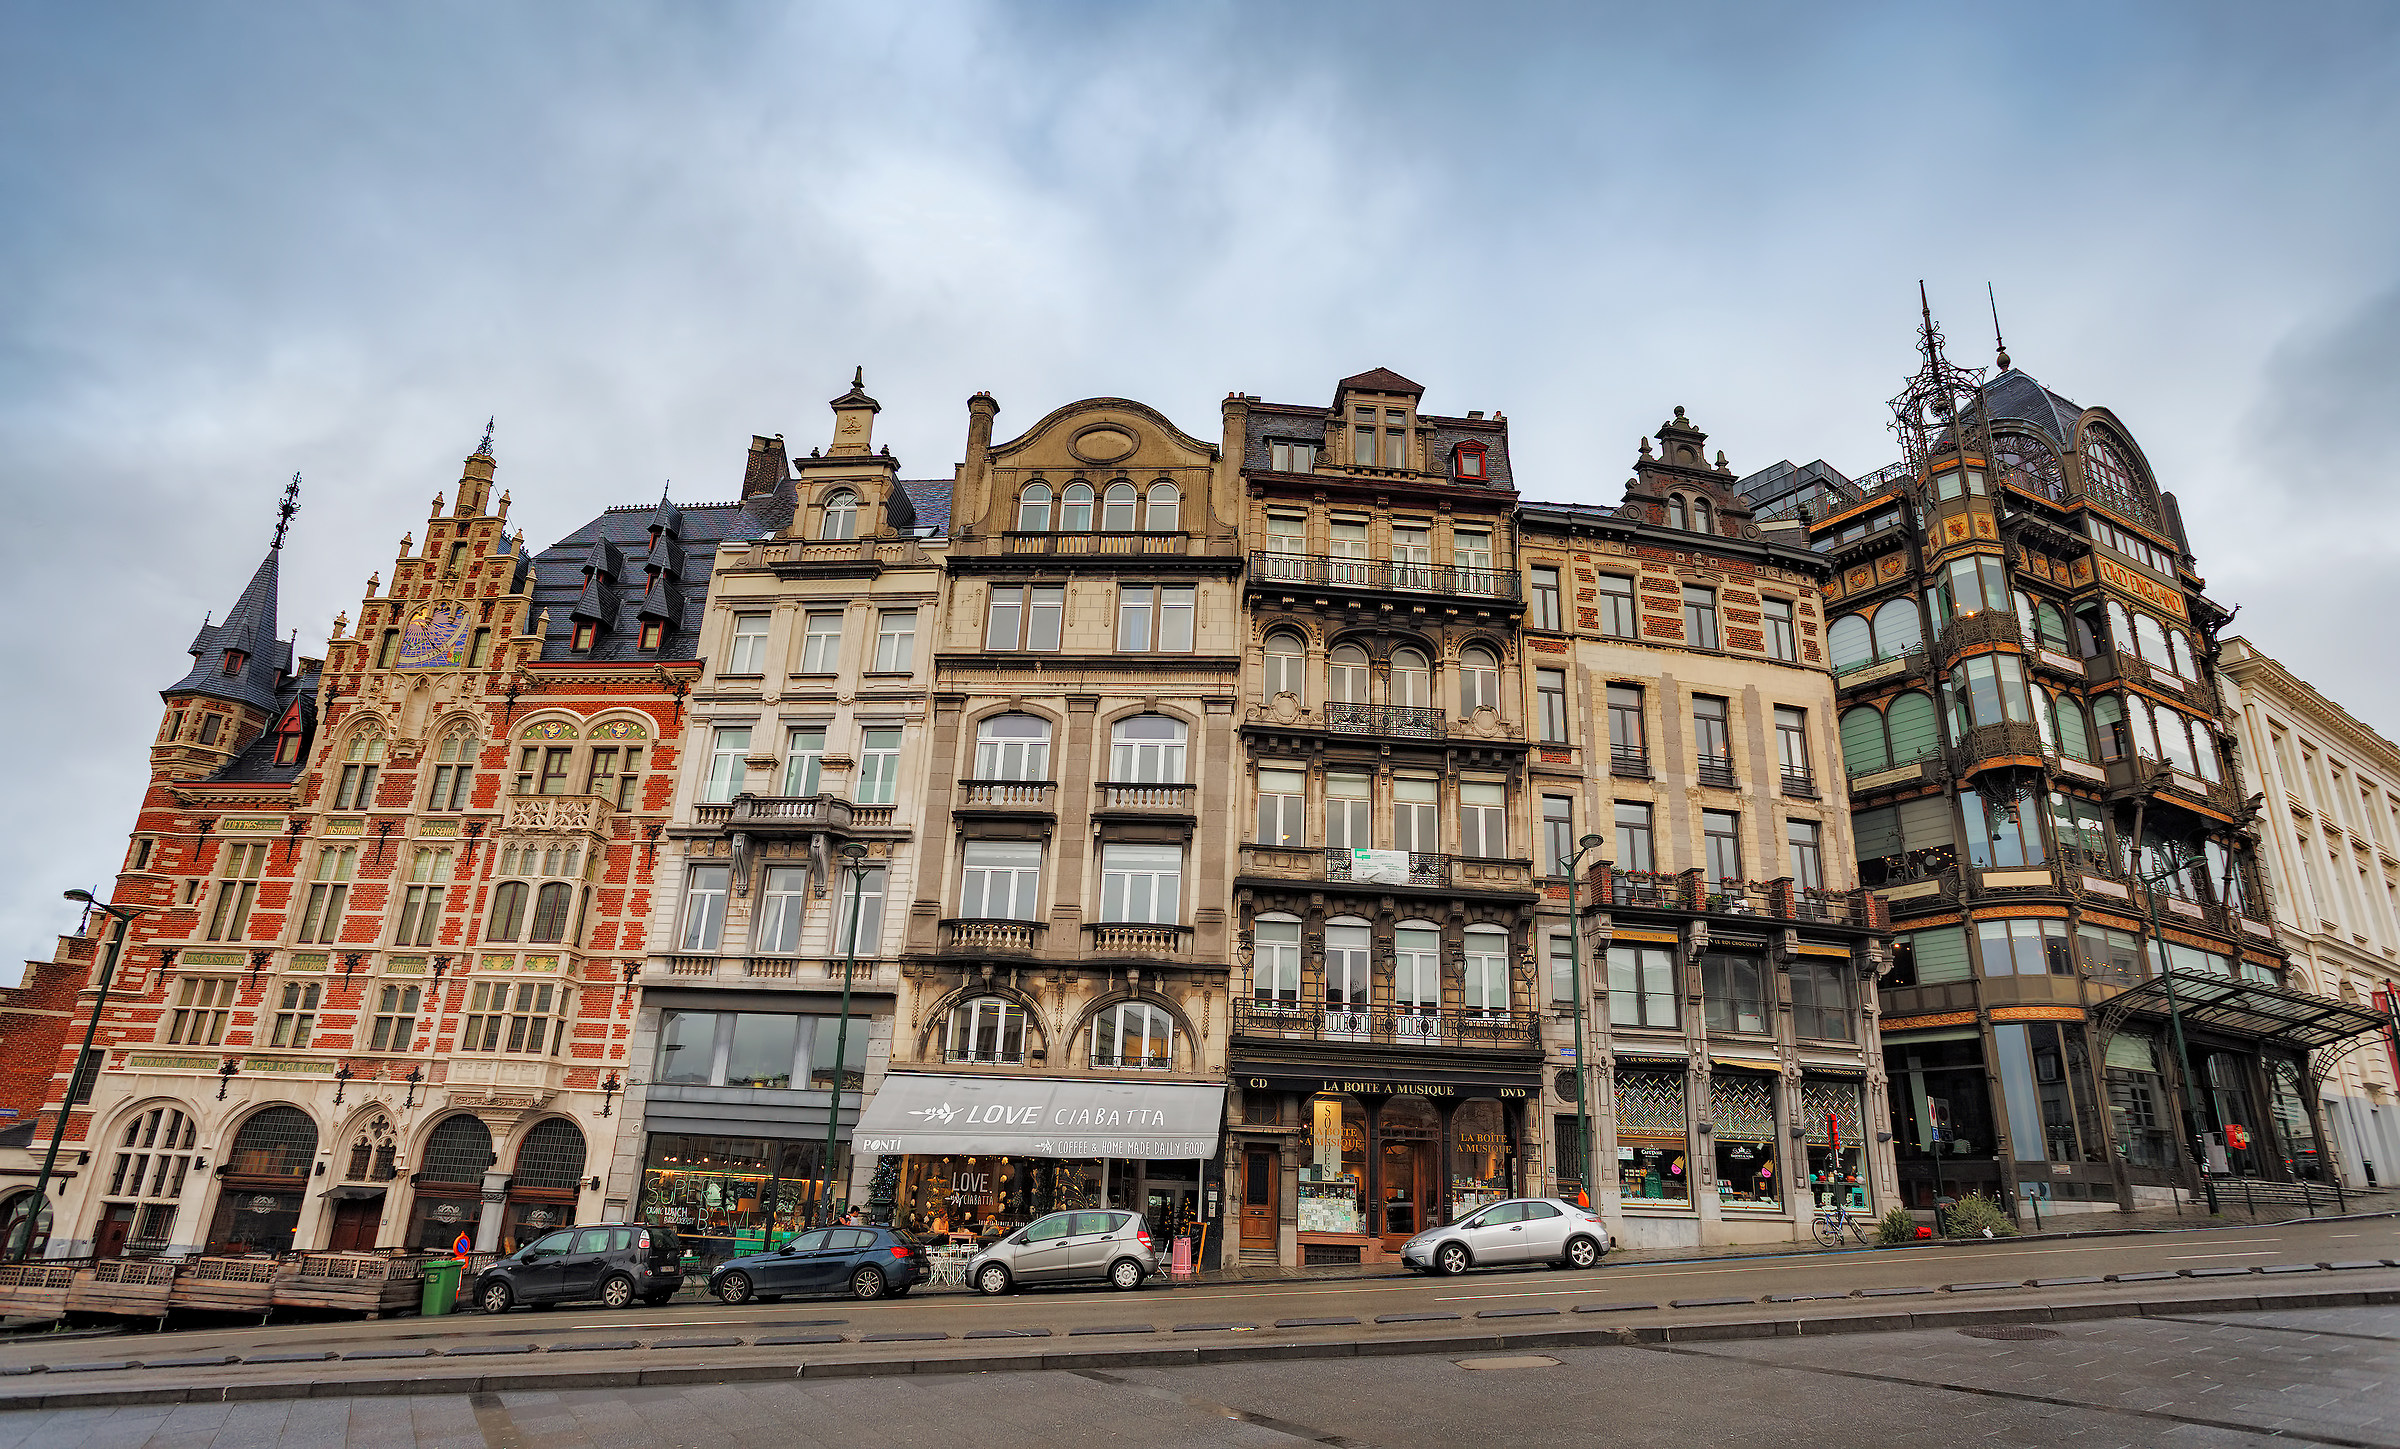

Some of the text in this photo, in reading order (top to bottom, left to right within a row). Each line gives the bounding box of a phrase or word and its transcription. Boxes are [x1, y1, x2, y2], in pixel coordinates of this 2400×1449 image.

[2101, 561, 2181, 612] OLD ENGLAND
[1250, 1078, 1268, 1089] CD
[1323, 1081, 1455, 1096] LA BOITE A MUSIQUE
[1500, 1087, 1526, 1098] DVD
[965, 1105, 1165, 1127] LOVE CIABATTA
[1461, 1131, 1508, 1143] LA BOÎTE
[1058, 1140, 1206, 1156] COFFEE & HOME MADE DAILY FOOD
[1456, 1143, 1513, 1154] A MUSIQUE
[963, 1194, 994, 1206] CIABATTA
